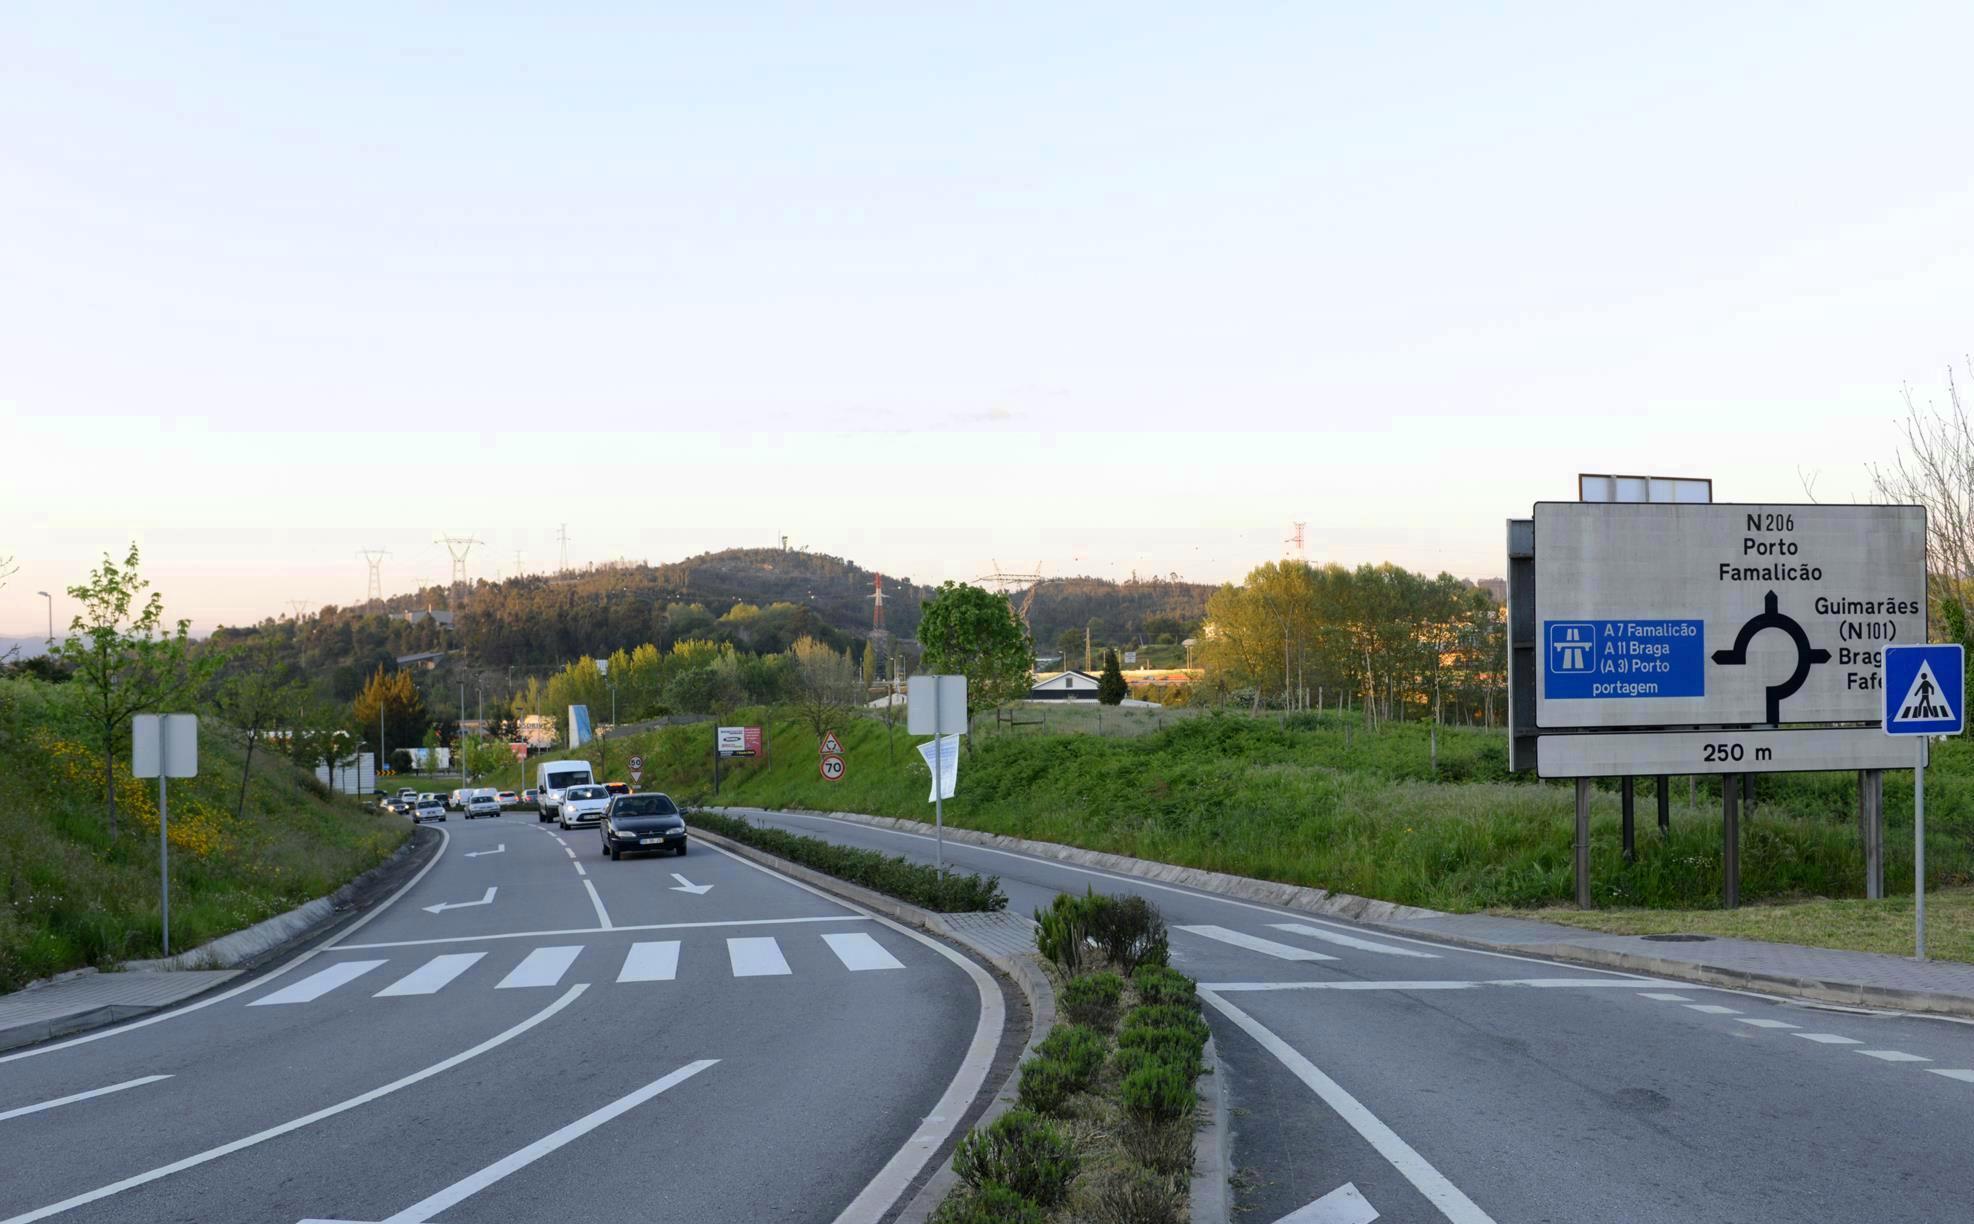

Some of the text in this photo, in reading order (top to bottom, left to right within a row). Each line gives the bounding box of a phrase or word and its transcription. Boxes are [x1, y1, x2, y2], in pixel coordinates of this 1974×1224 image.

[1743, 537, 1798, 556] Porto
[1719, 563, 1823, 581] Famalicão
[1814, 597, 1919, 615] Guimarães
[1627, 623, 1697, 637] Famalicão
[1629, 641, 1670, 657] Braga
[1839, 647, 1882, 668] Brag
[1632, 659, 1670, 673] Porto
[1593, 680, 1659, 696] portagem
[1703, 743, 1772, 762] 250 m
[825, 762, 842, 773] 70
